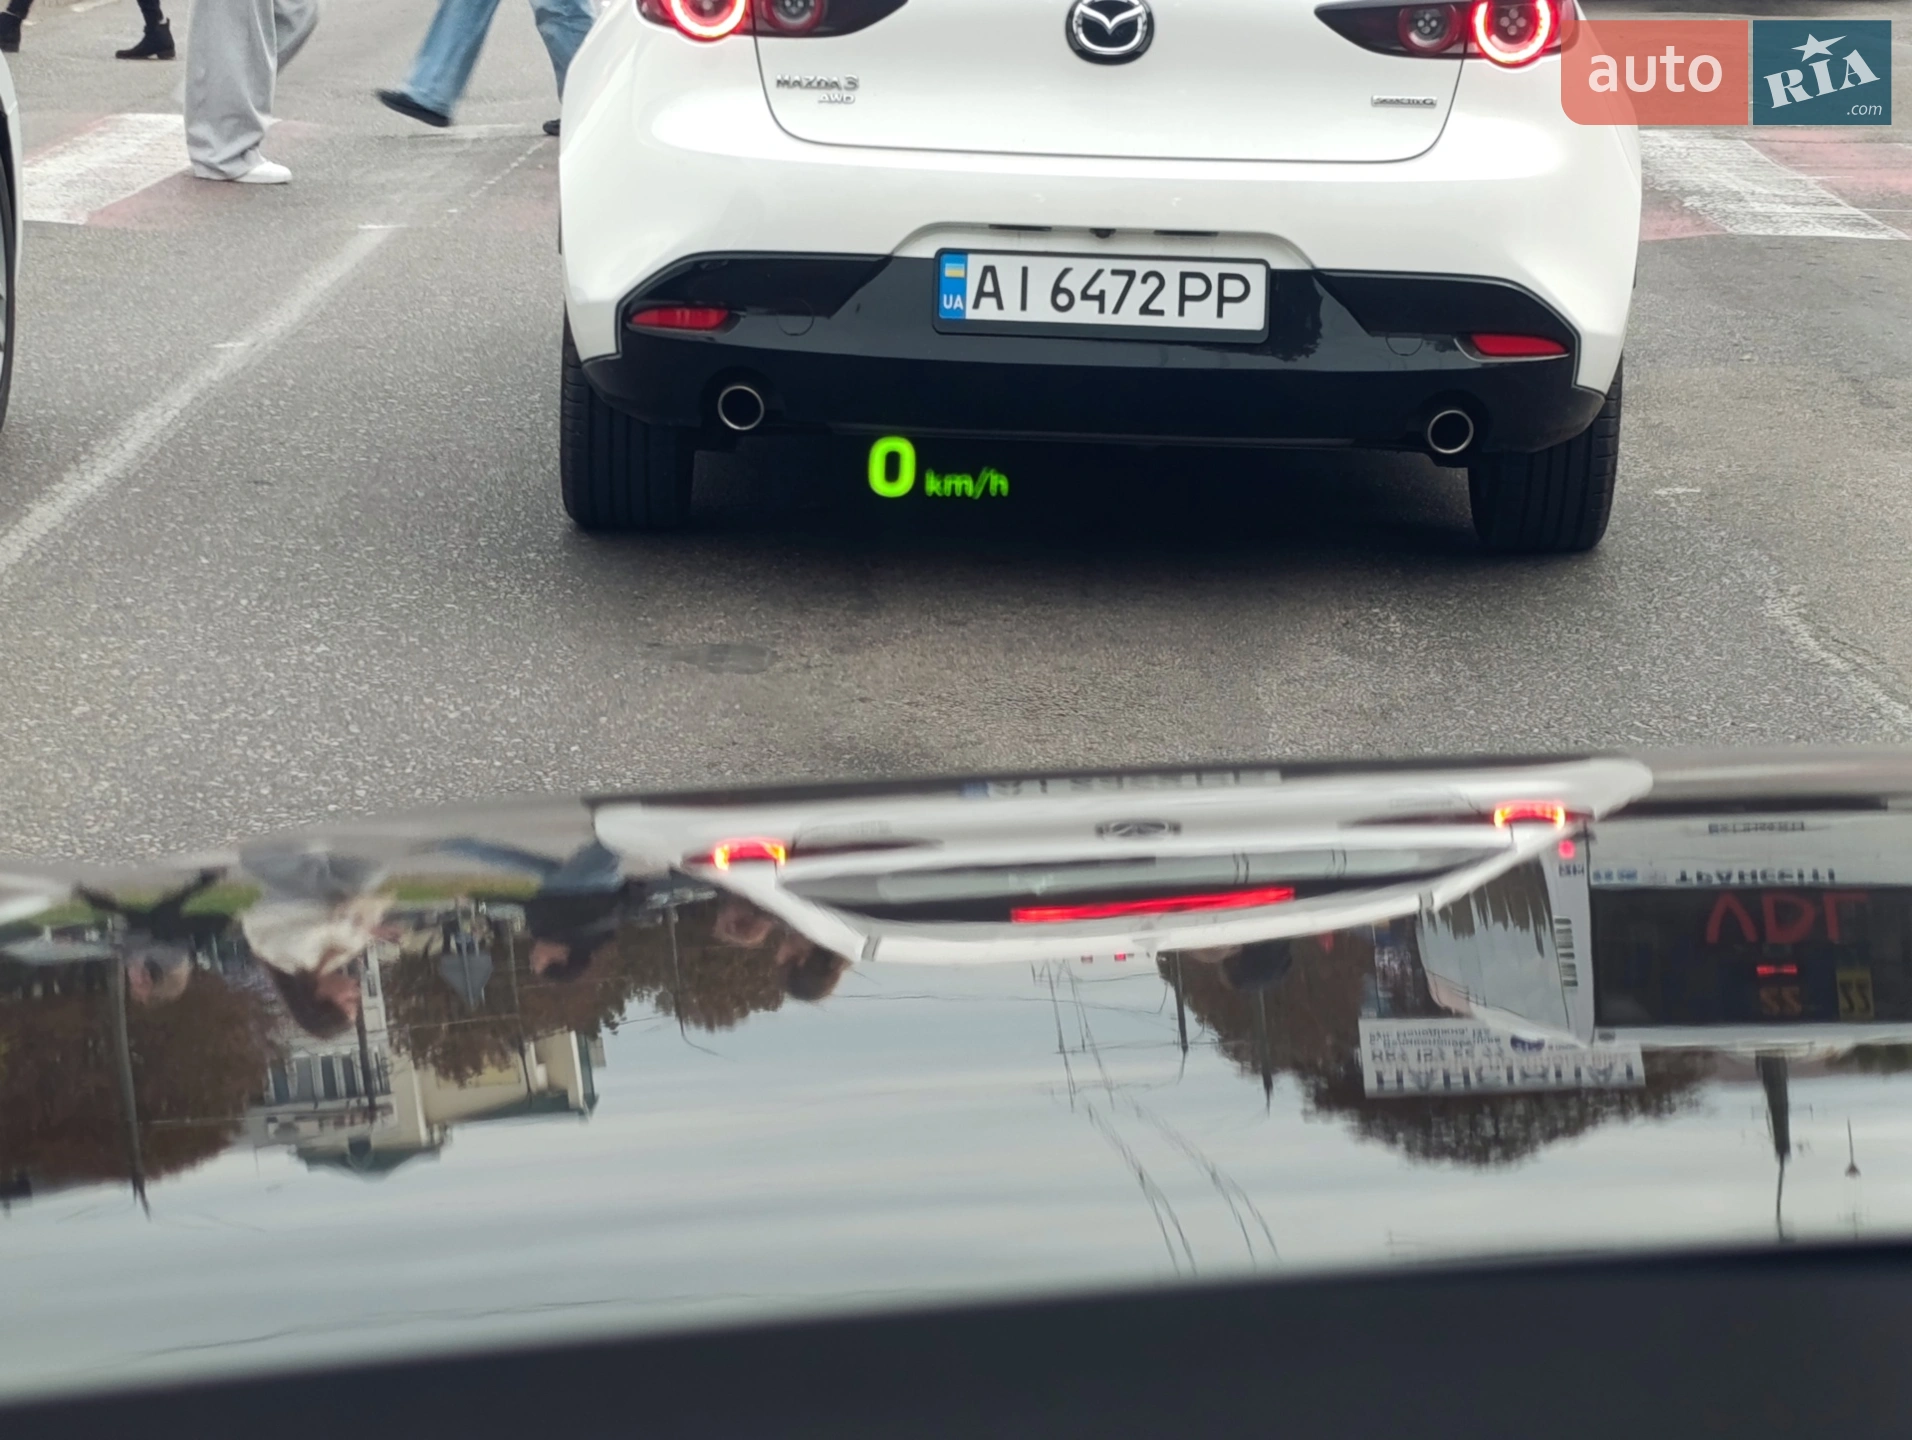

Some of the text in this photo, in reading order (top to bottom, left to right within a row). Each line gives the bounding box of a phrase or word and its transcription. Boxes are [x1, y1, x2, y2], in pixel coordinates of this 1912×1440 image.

[818, 93, 856, 104] AWD
[943, 294, 964, 310] UA
[868, 436, 1009, 499] 0 km/h
